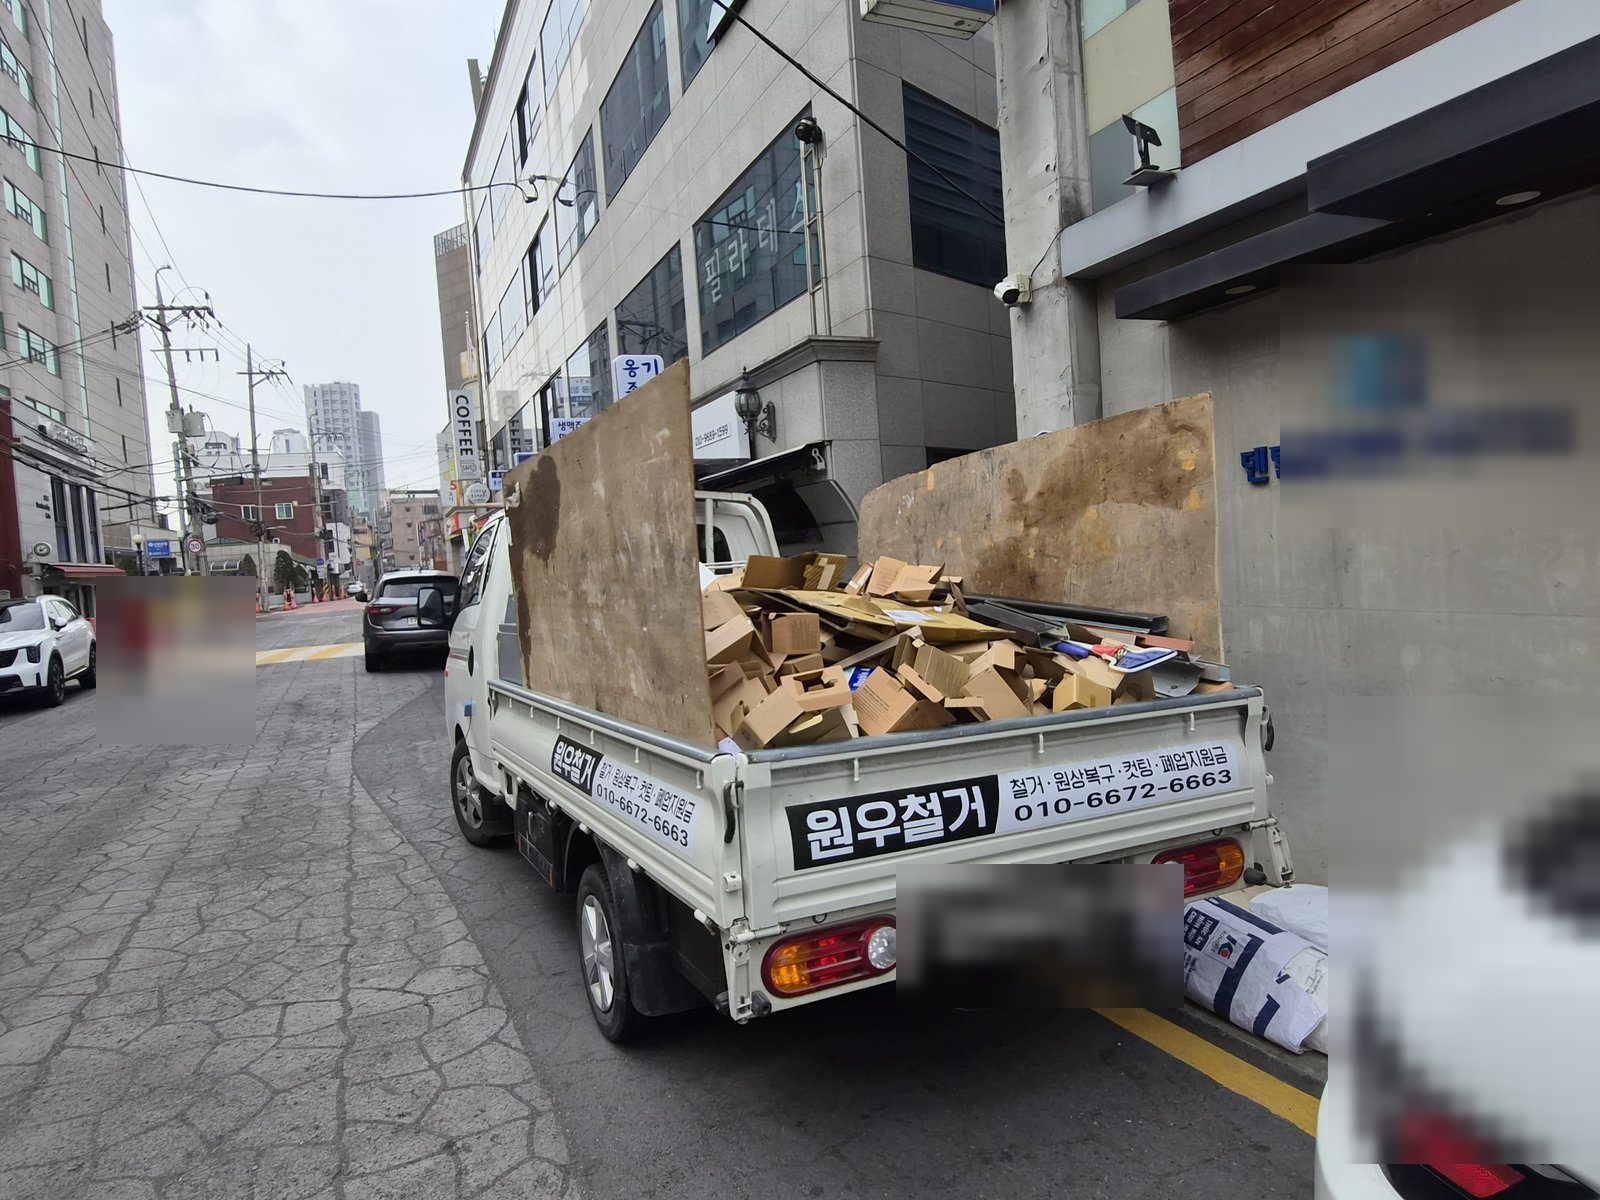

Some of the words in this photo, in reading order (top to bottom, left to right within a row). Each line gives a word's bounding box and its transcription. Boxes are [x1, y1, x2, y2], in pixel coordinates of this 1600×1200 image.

[622, 358, 659, 378] 옹기
[455, 394, 474, 456] COFFEE
[553, 741, 596, 790] 원우철거
[596, 783, 689, 848] 010-6672-6663
[806, 785, 986, 861] 원우철거
[1014, 769, 1232, 821] 010-6672-6663
